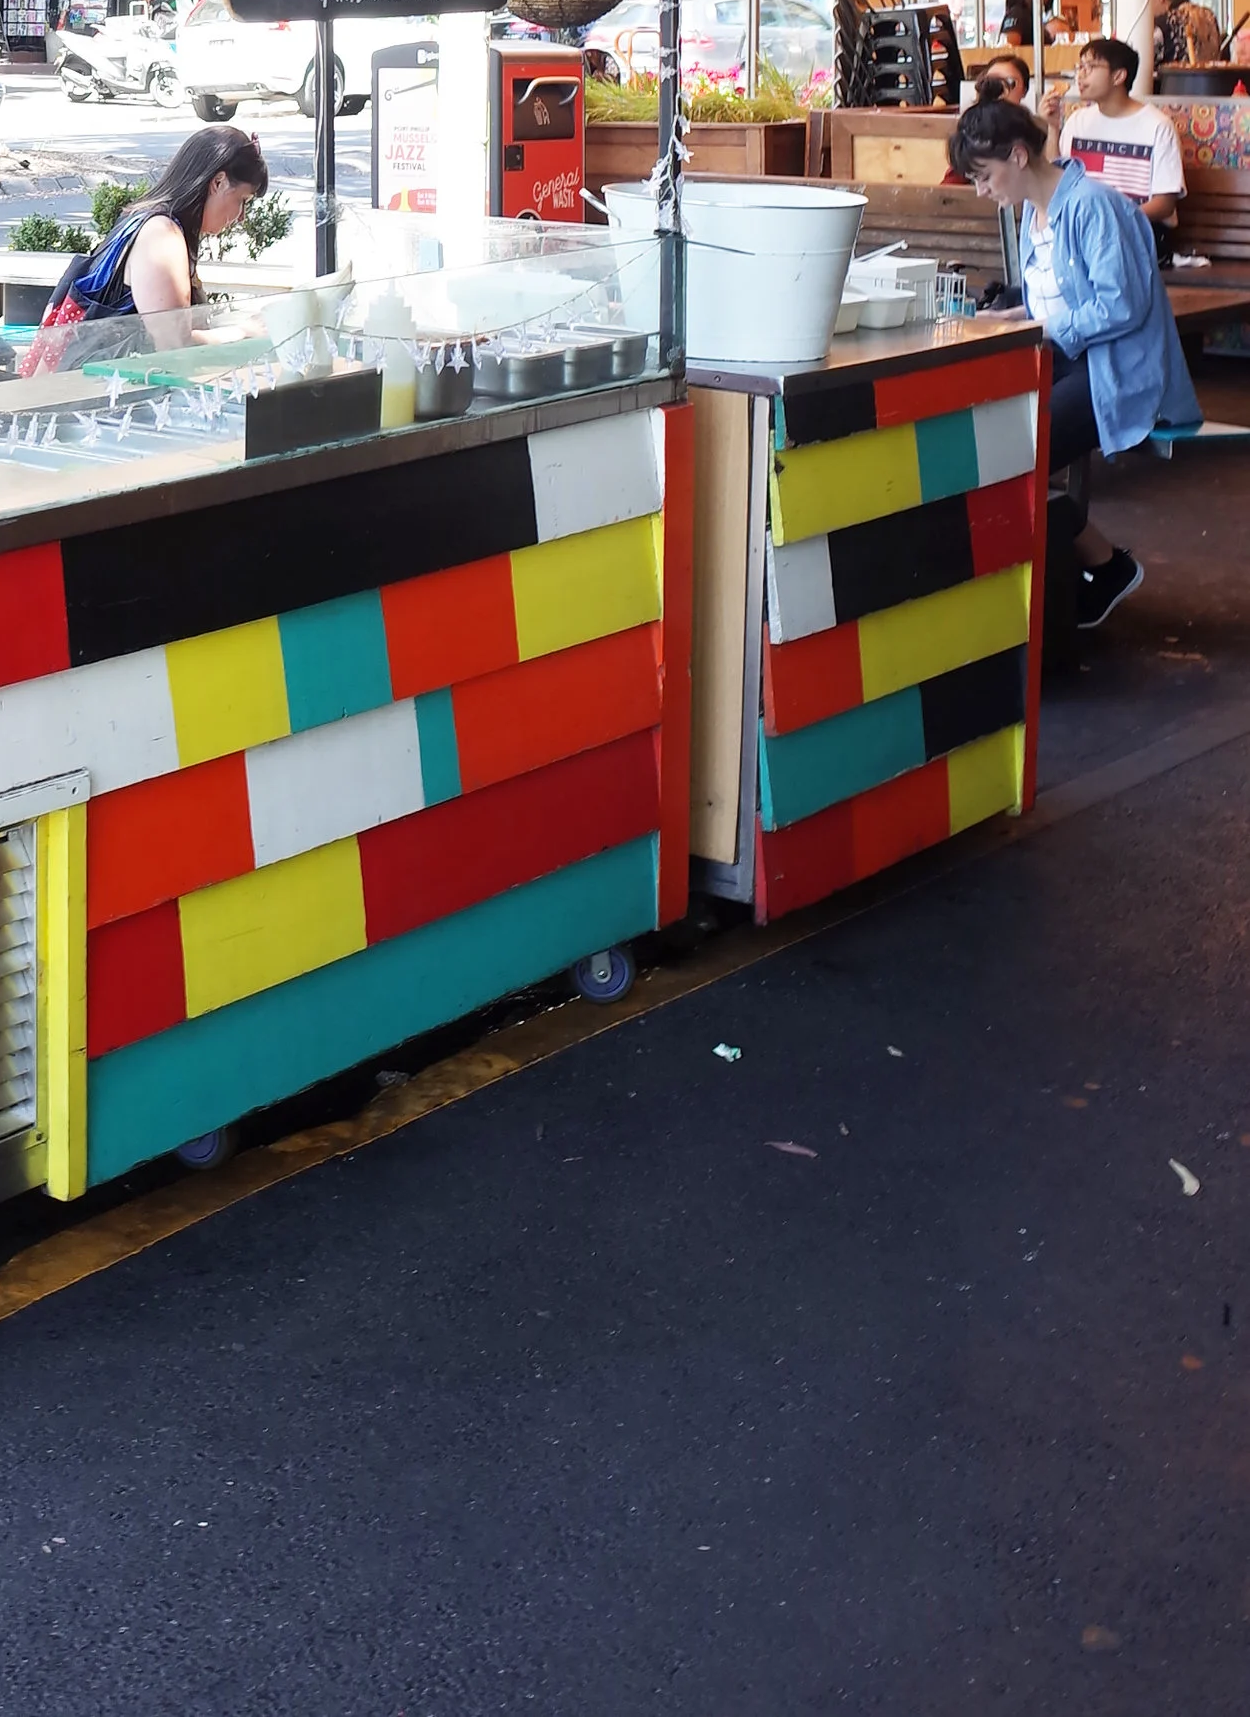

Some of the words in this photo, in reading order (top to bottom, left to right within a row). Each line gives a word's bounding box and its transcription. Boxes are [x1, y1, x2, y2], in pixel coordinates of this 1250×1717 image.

[385, 145, 425, 161] JAZZ
[393, 162, 427, 171] FESTIVAL
[533, 167, 580, 212] General
[553, 188, 575, 209] WASTE
